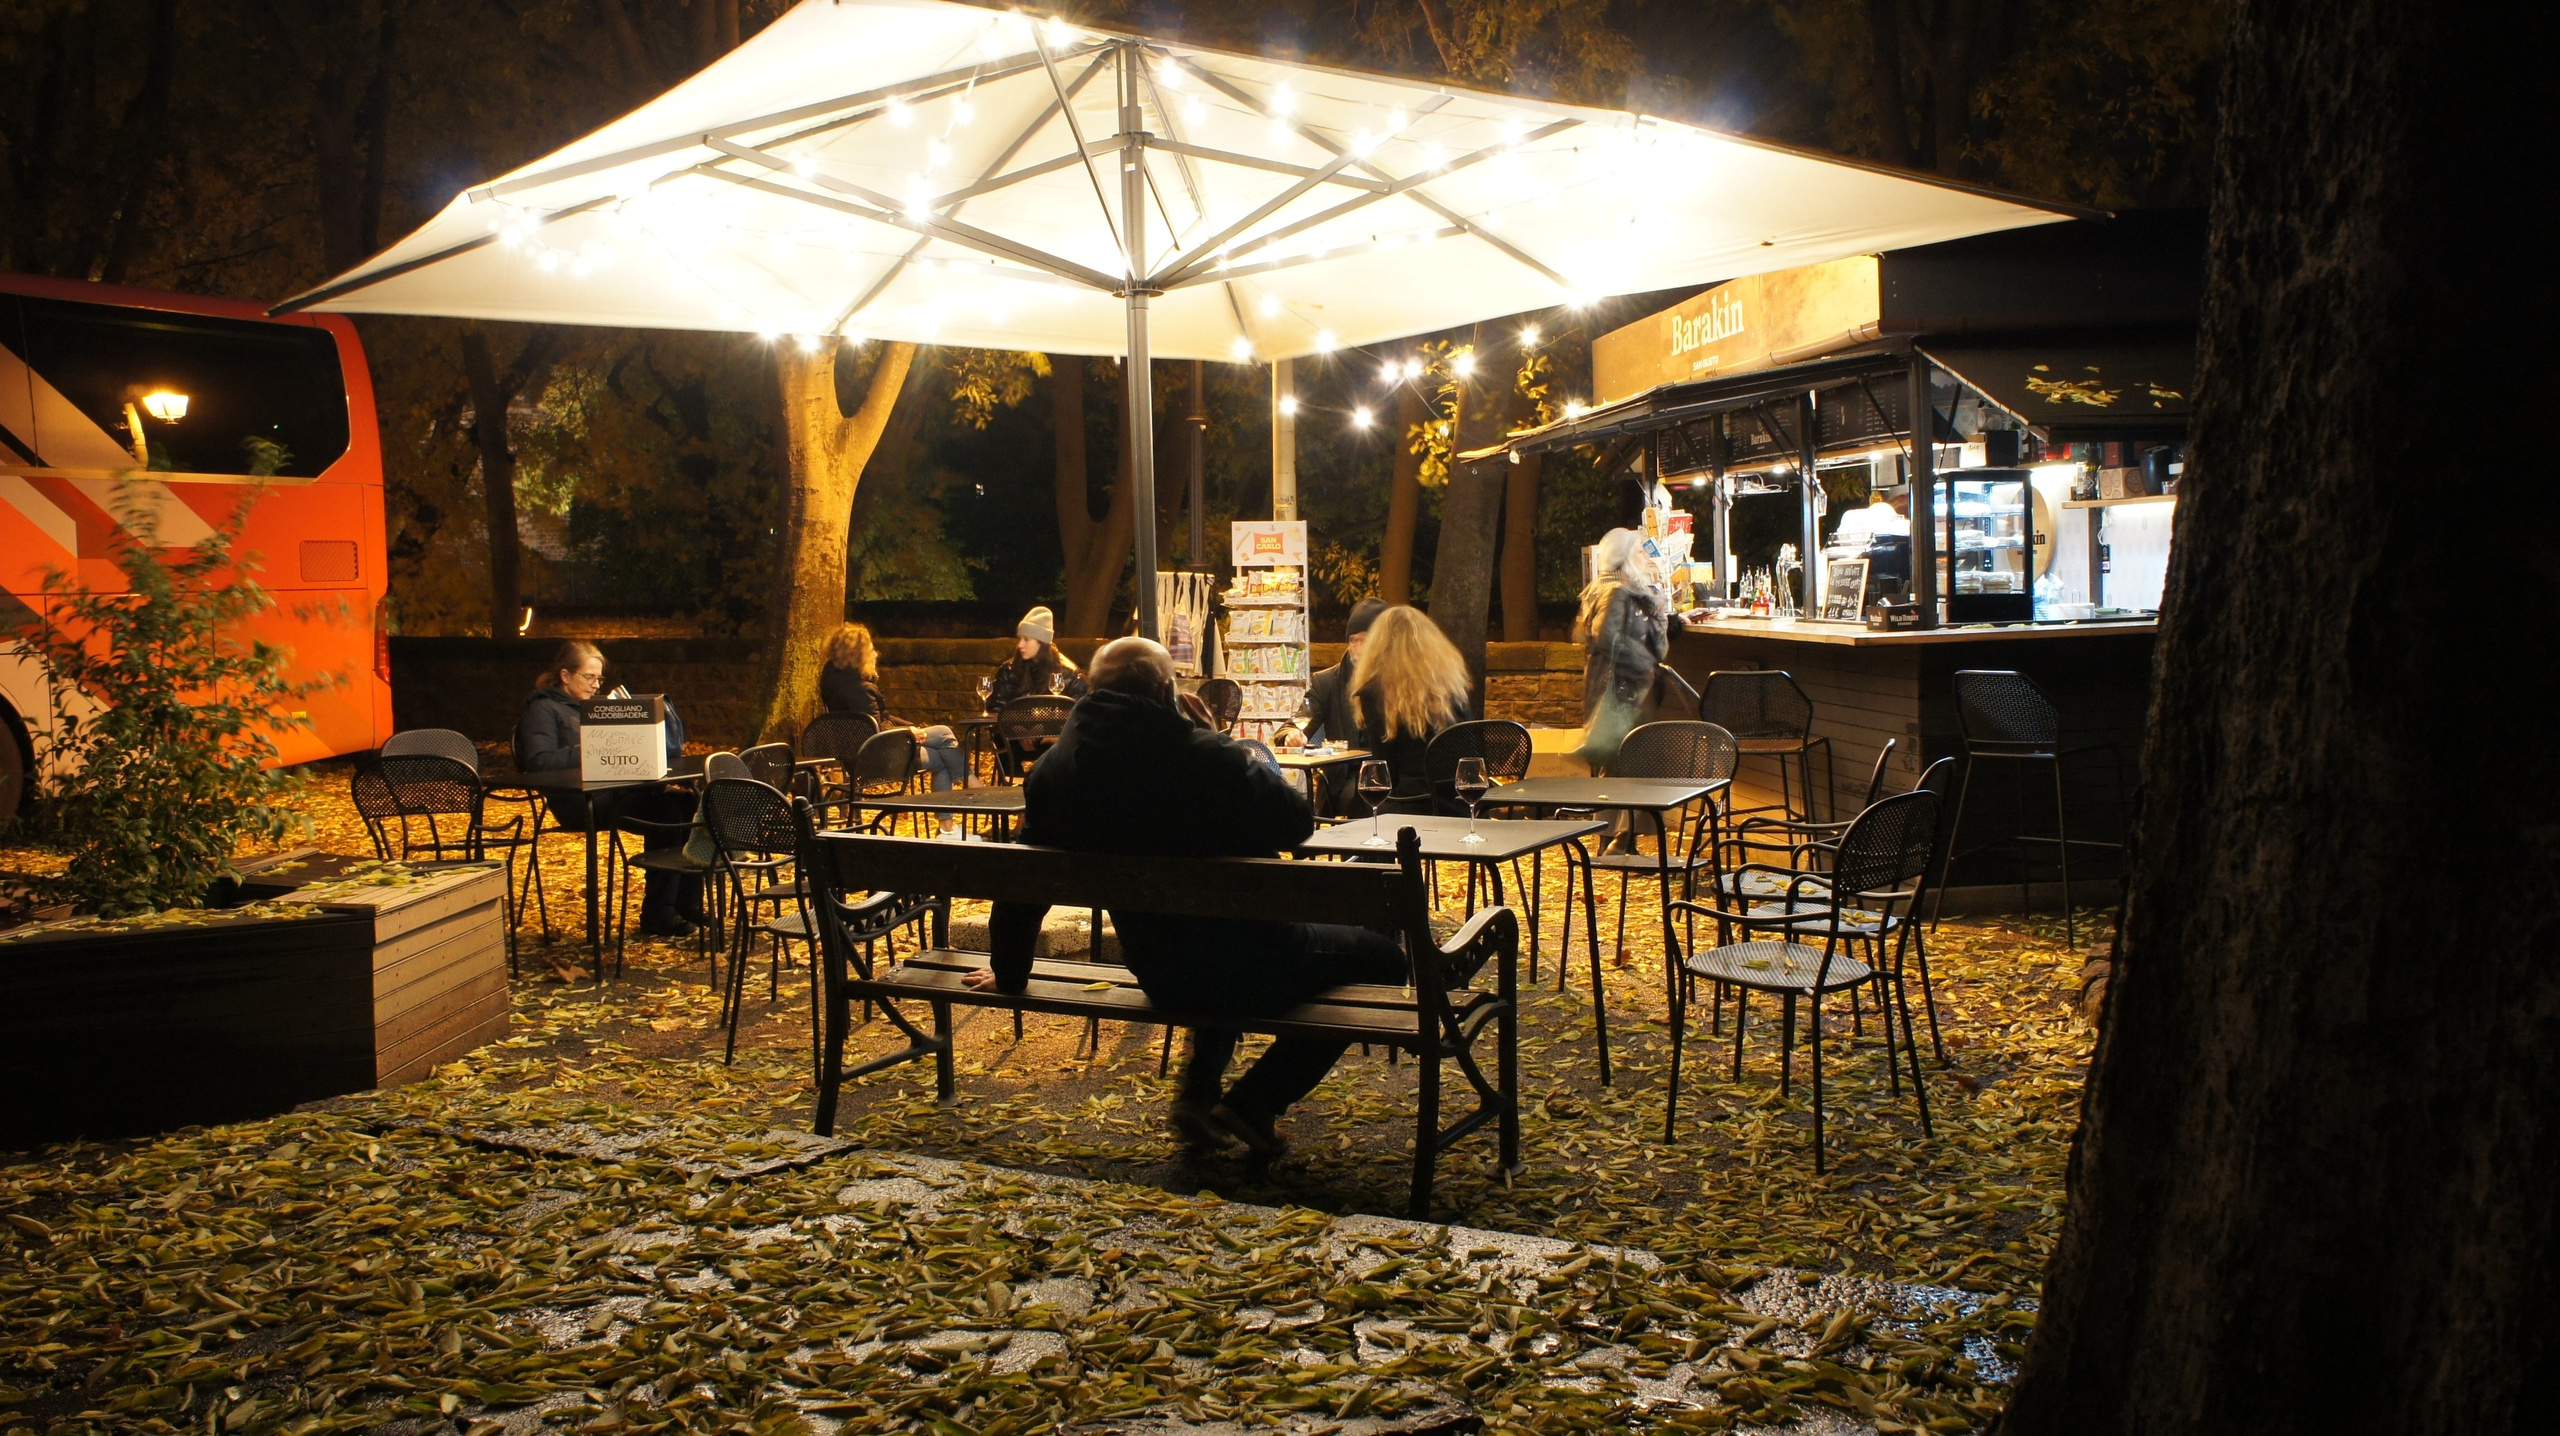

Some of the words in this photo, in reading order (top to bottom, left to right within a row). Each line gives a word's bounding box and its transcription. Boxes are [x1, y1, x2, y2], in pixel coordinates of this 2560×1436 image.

[1671, 290, 1745, 357] Barakin
[1902, 614, 1919, 622] TURKEY
[588, 711, 649, 719] VALDOBBIADENE
[600, 755, 639, 766] SUTTO
